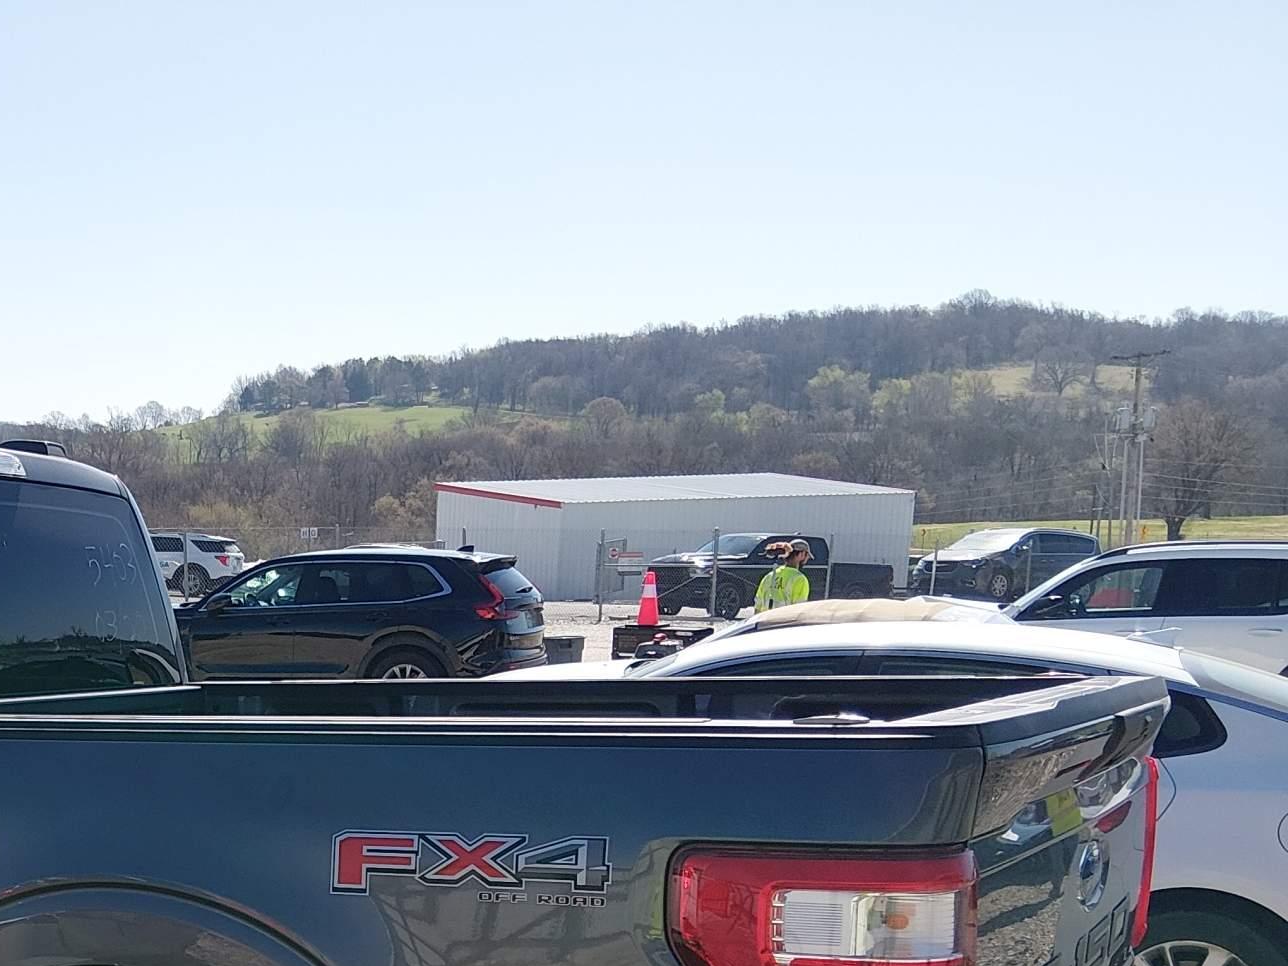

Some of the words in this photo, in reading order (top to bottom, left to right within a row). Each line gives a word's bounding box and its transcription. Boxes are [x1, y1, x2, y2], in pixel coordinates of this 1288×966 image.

[329, 829, 612, 896] FX4
[478, 891, 528, 904] OFF
[536, 893, 607, 908] ROAD
